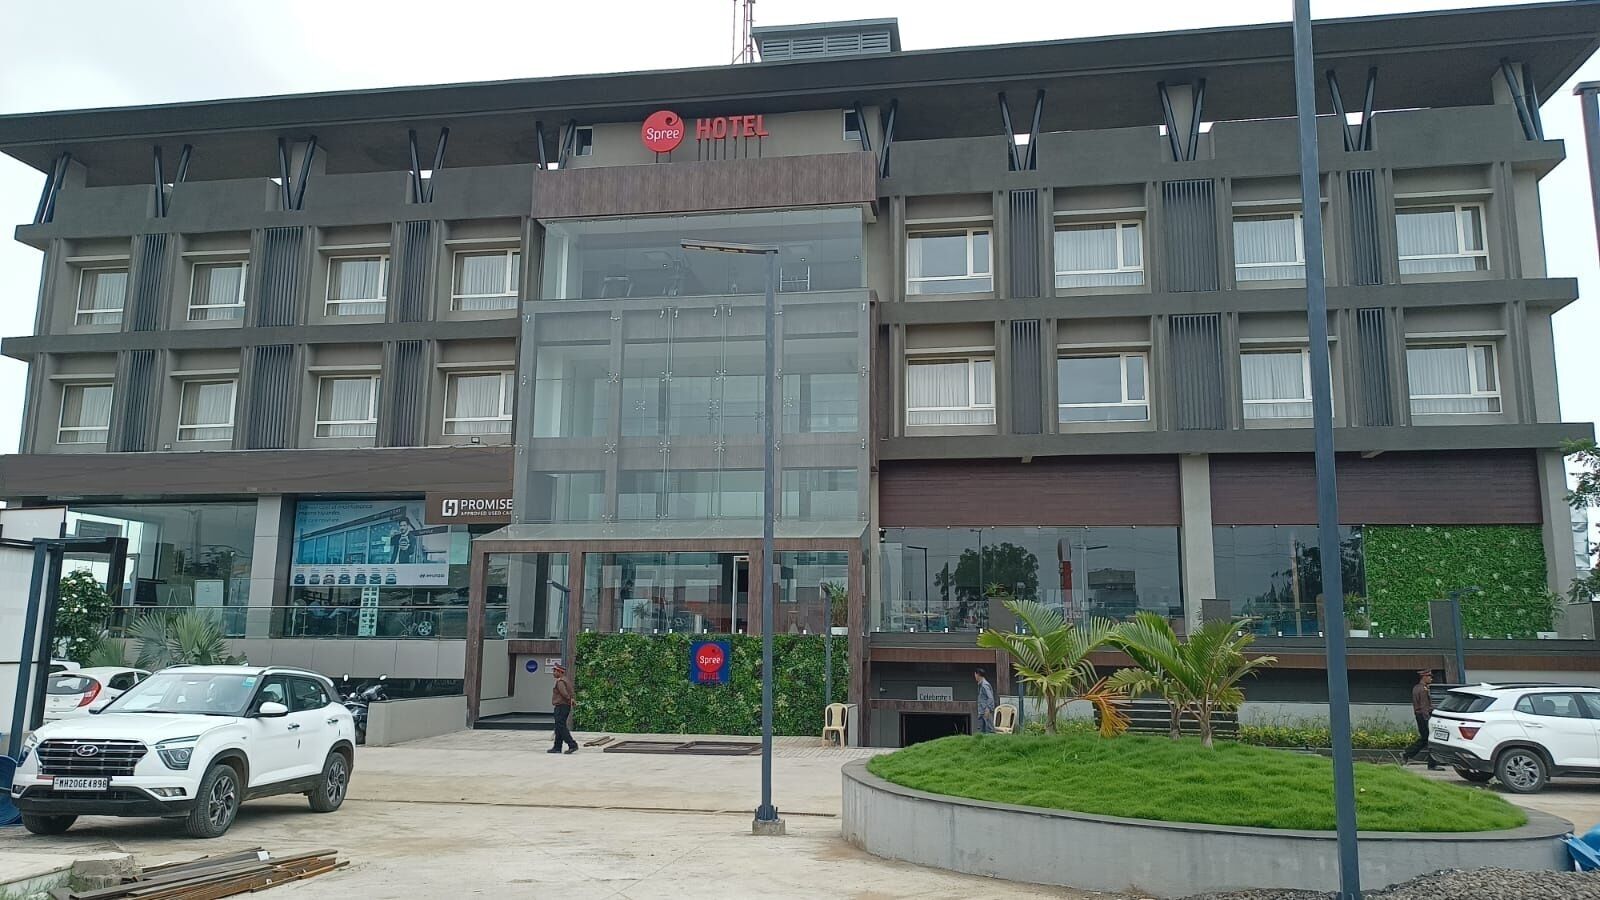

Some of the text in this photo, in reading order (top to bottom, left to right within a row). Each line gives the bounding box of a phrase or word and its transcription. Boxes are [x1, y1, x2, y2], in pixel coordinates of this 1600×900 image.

[696, 115, 769, 141] HOTEL
[646, 128, 680, 142] Spree
[460, 499, 513, 510] PROMISE
[699, 655, 721, 666] Spree
